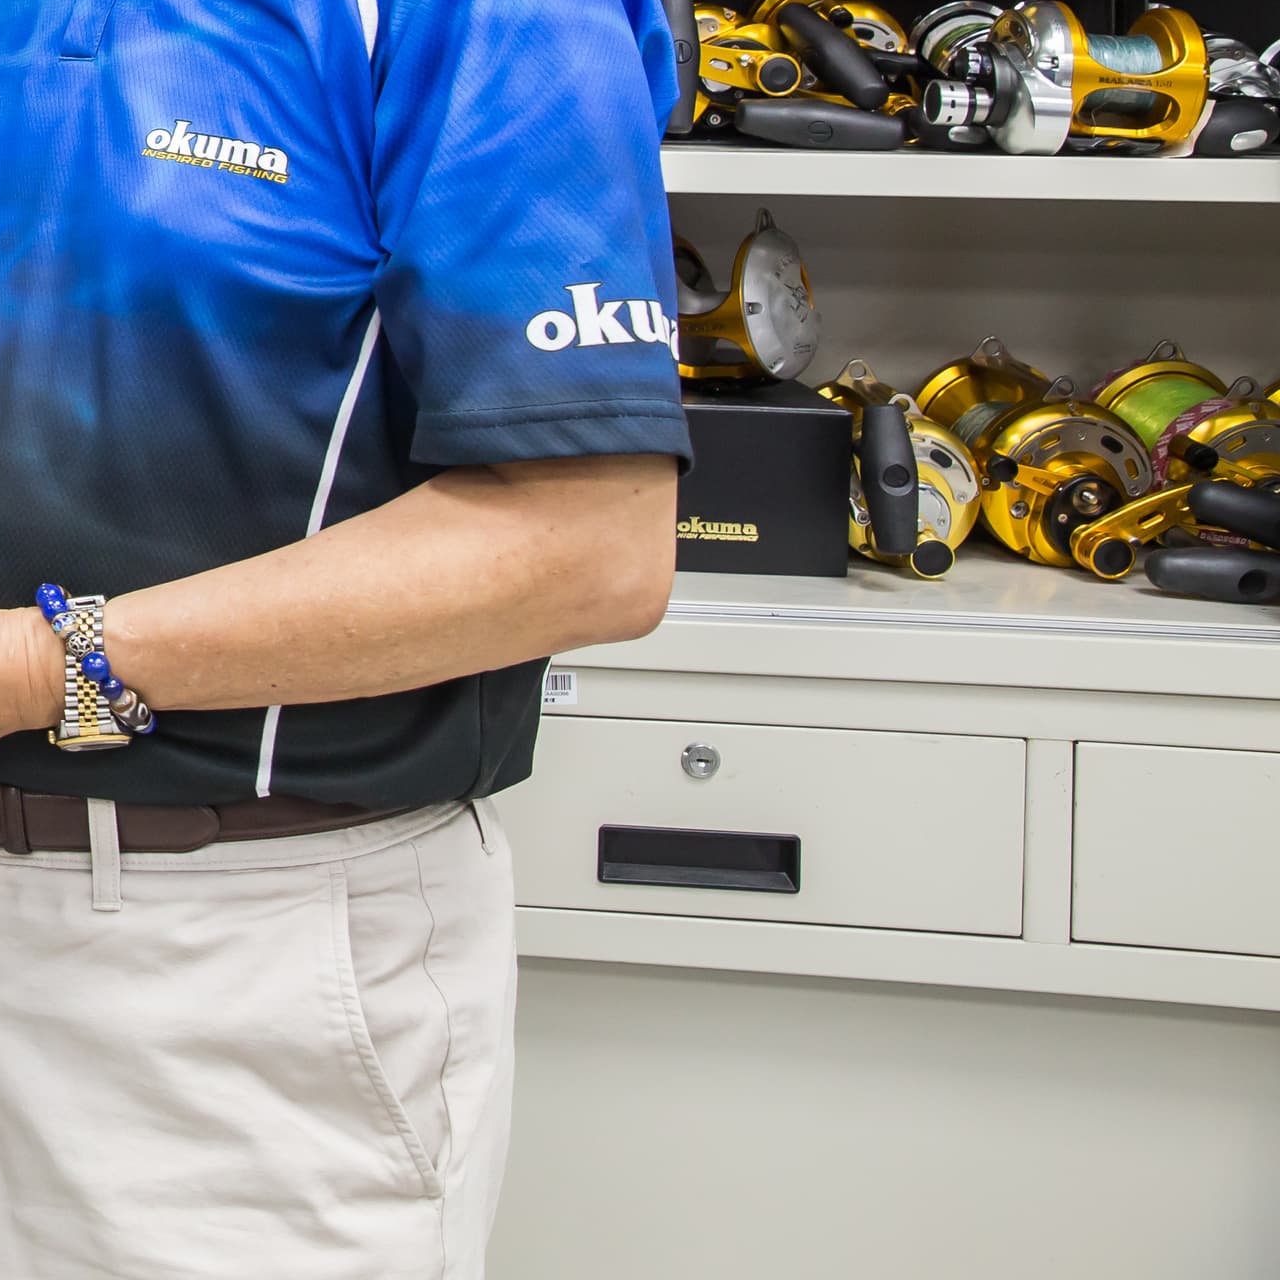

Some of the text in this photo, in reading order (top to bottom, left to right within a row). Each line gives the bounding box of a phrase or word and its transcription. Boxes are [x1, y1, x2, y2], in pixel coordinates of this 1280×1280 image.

[145, 119, 290, 176] okuma
[141, 148, 289, 185] INSPIRED FISHING
[676, 516, 758, 535] okuma
